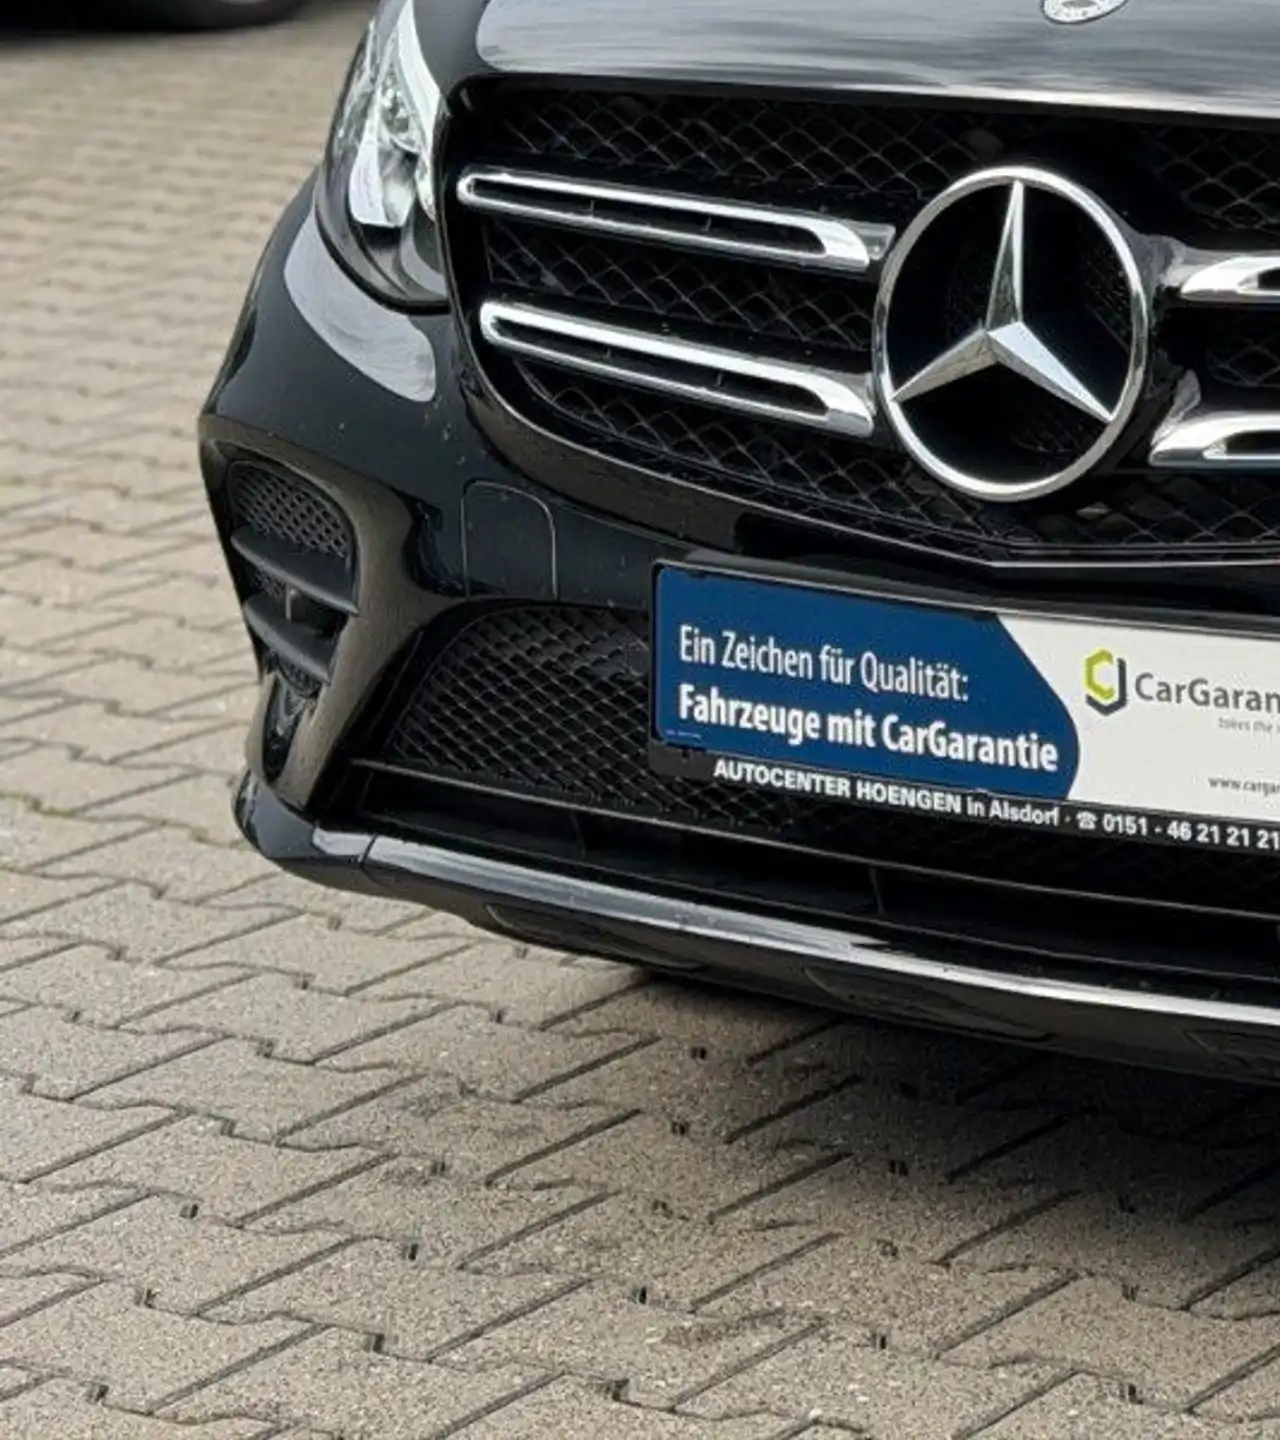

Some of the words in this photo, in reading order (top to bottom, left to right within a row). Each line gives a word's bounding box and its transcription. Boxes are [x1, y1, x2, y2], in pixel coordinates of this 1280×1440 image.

[679, 624, 716, 666] Ein
[721, 629, 813, 680] Zeichen
[817, 644, 855, 686] für
[860, 650, 969, 703] Qualität:
[678, 682, 821, 747] Fahrzeuge
[827, 708, 877, 748] mit
[881, 713, 1059, 772] CarGarantie
[713, 758, 851, 798] AUTOCENTER
[856, 779, 962, 815] HOENGEN
[967, 796, 985, 818] in
[989, 799, 1061, 827] Alsdorf
[1102, 813, 1148, 837] 0151
[1166, 820, 1192, 842] 46
[1196, 823, 1221, 845] 21
[1226, 826, 1250, 848] 21
